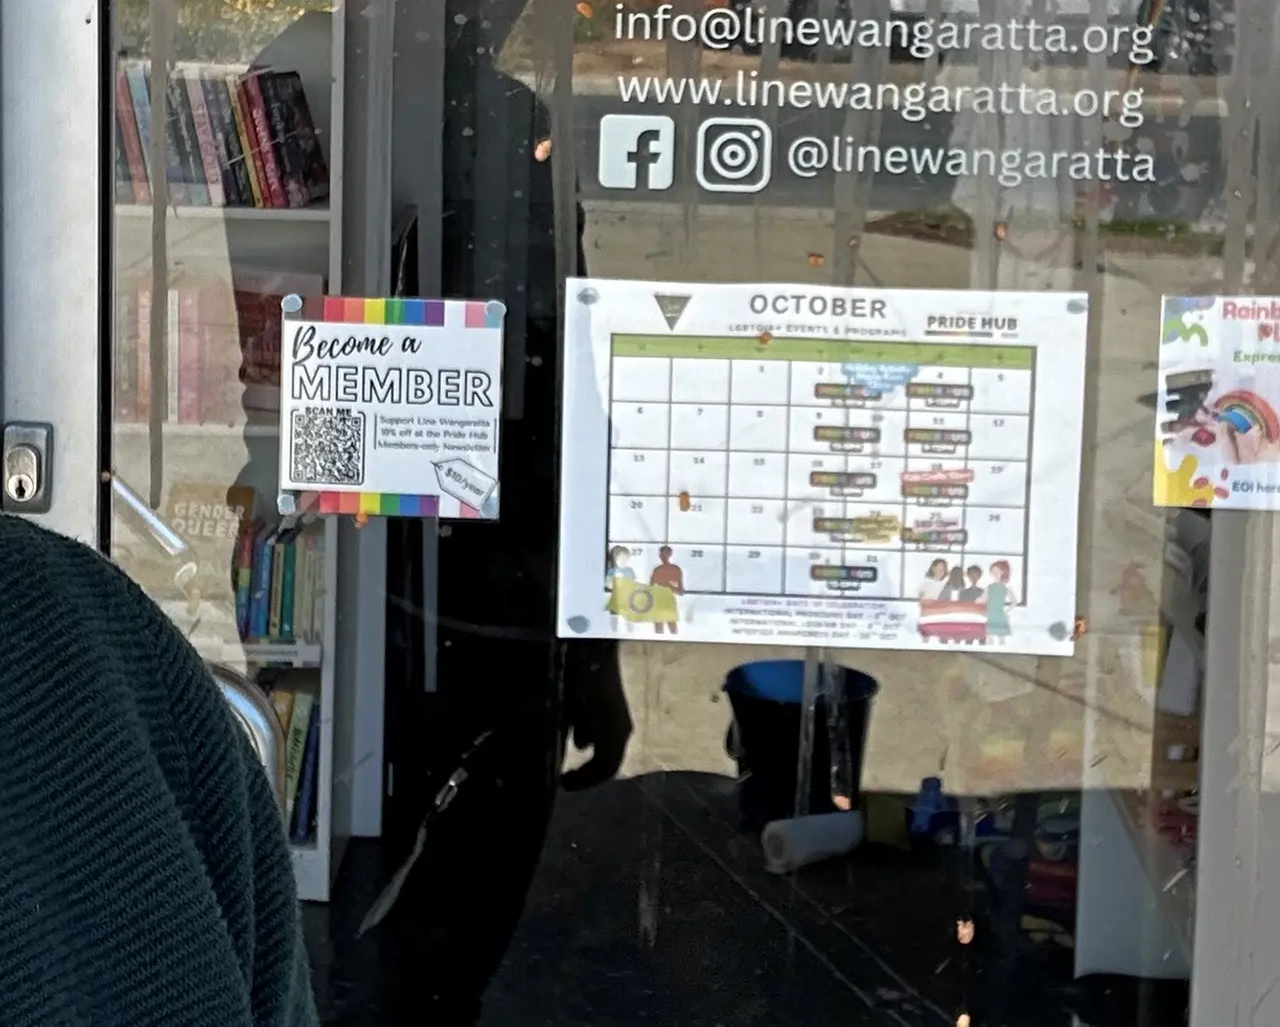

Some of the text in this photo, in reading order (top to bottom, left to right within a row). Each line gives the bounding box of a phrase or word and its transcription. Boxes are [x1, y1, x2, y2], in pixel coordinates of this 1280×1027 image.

[614, 4, 1155, 62] info@linewangaratta.org
[618, 70, 1145, 126] www.linewangaratta.org
[787, 135, 1157, 189] @linewangaratta
[750, 294, 888, 319] OCTOBER
[787, 325, 828, 334] EVENTS
[927, 315, 1018, 331] PRIDE HUB
[292, 325, 422, 365] Become a
[291, 362, 494, 408] MEMBER
[305, 407, 352, 417] SCAN ME
[1232, 481, 1254, 493] EOI
[174, 503, 245, 521] GENDER
[171, 517, 240, 539] QUEER
